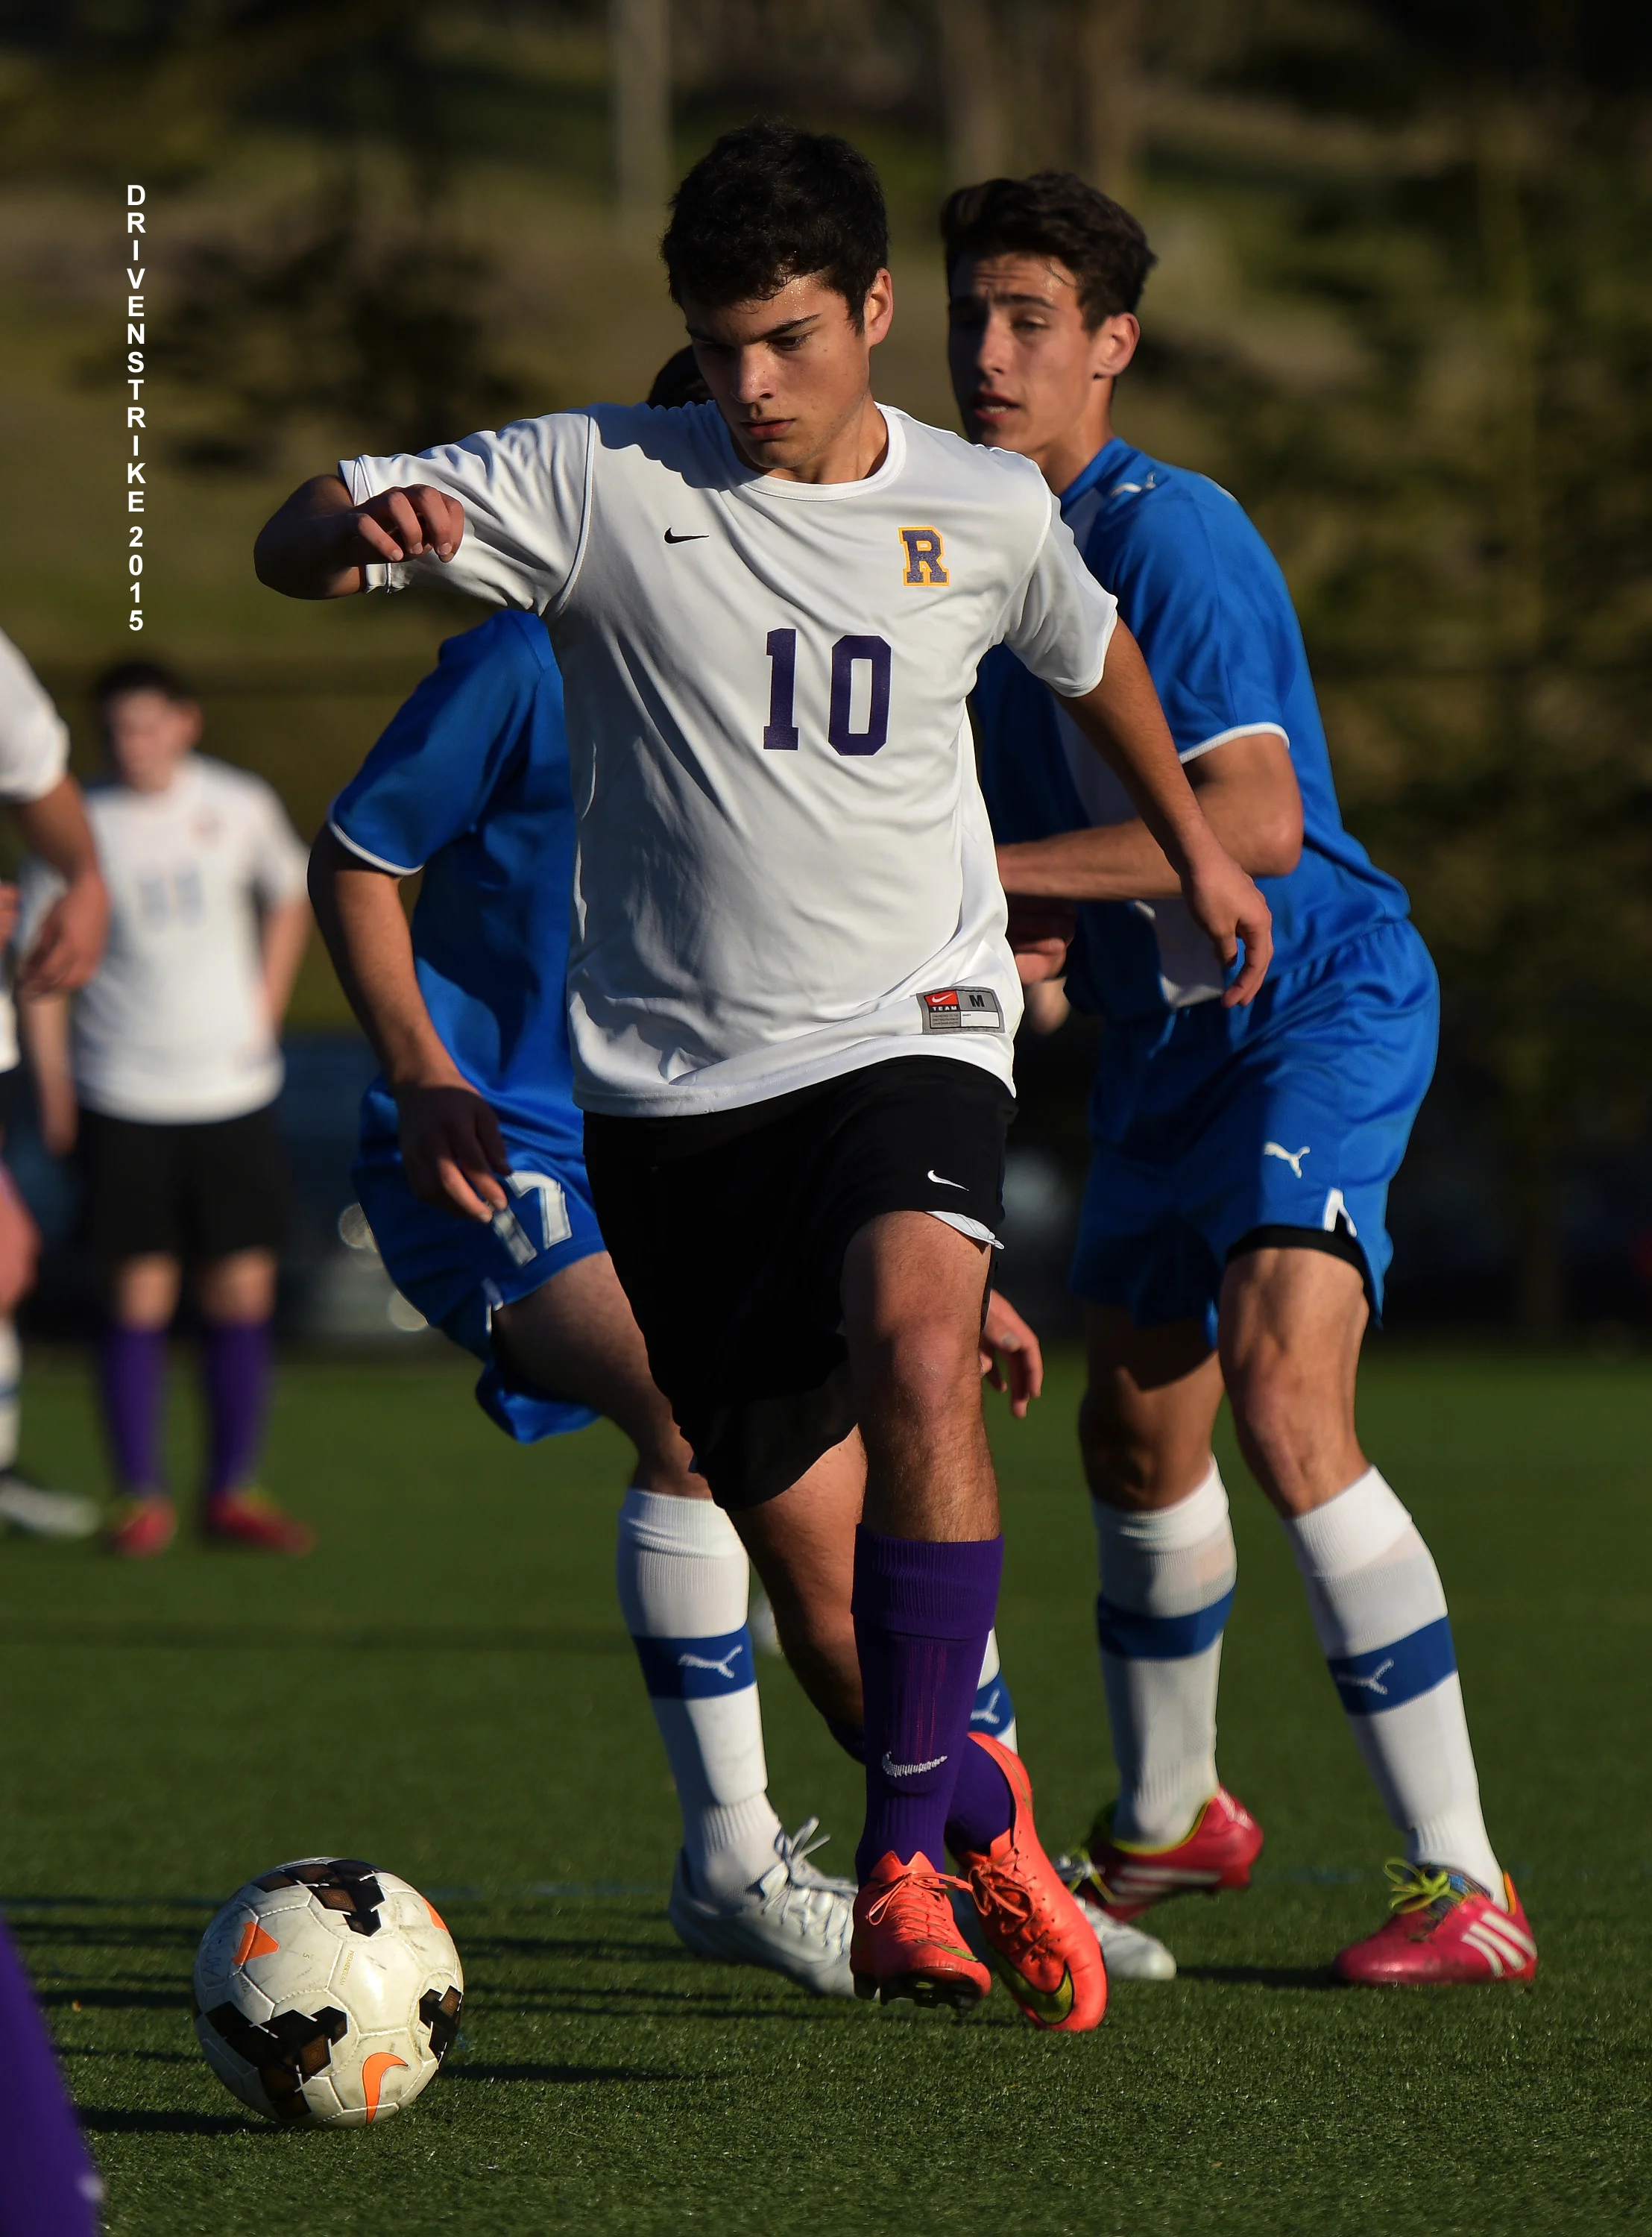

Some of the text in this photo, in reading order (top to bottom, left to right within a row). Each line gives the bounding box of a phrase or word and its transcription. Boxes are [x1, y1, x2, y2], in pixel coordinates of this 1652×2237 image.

[898, 526, 950, 586] R
[763, 627, 893, 757] 10
[969, 994, 985, 1007] M
